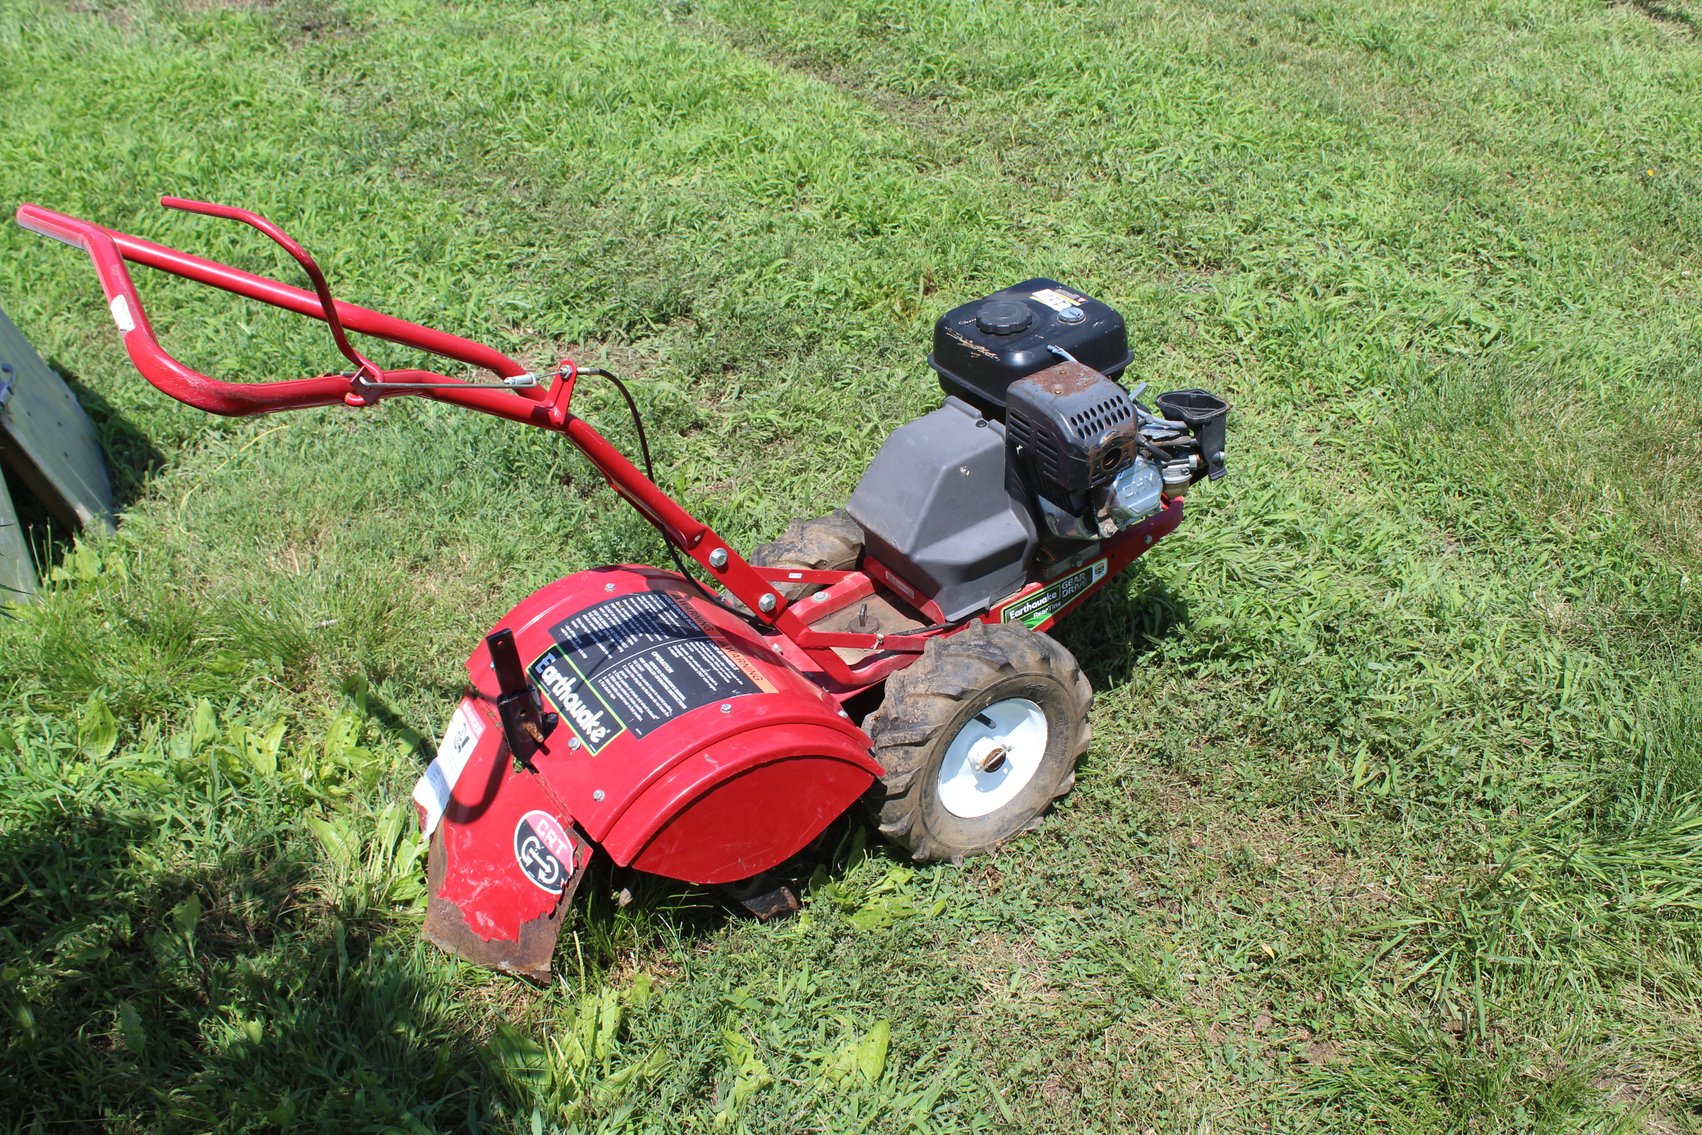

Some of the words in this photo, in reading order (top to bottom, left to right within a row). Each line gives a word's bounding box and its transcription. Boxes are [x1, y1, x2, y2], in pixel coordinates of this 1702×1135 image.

[1124, 472, 1154, 498] OHV
[1062, 572, 1087, 590] GEAR
[1062, 580, 1088, 598] DRIVE
[678, 596, 714, 632] WARNING
[1009, 591, 1057, 620] Earthquake
[724, 645, 763, 682] WARNING
[535, 652, 606, 744] Earthquake
[537, 819, 568, 857] CRT
